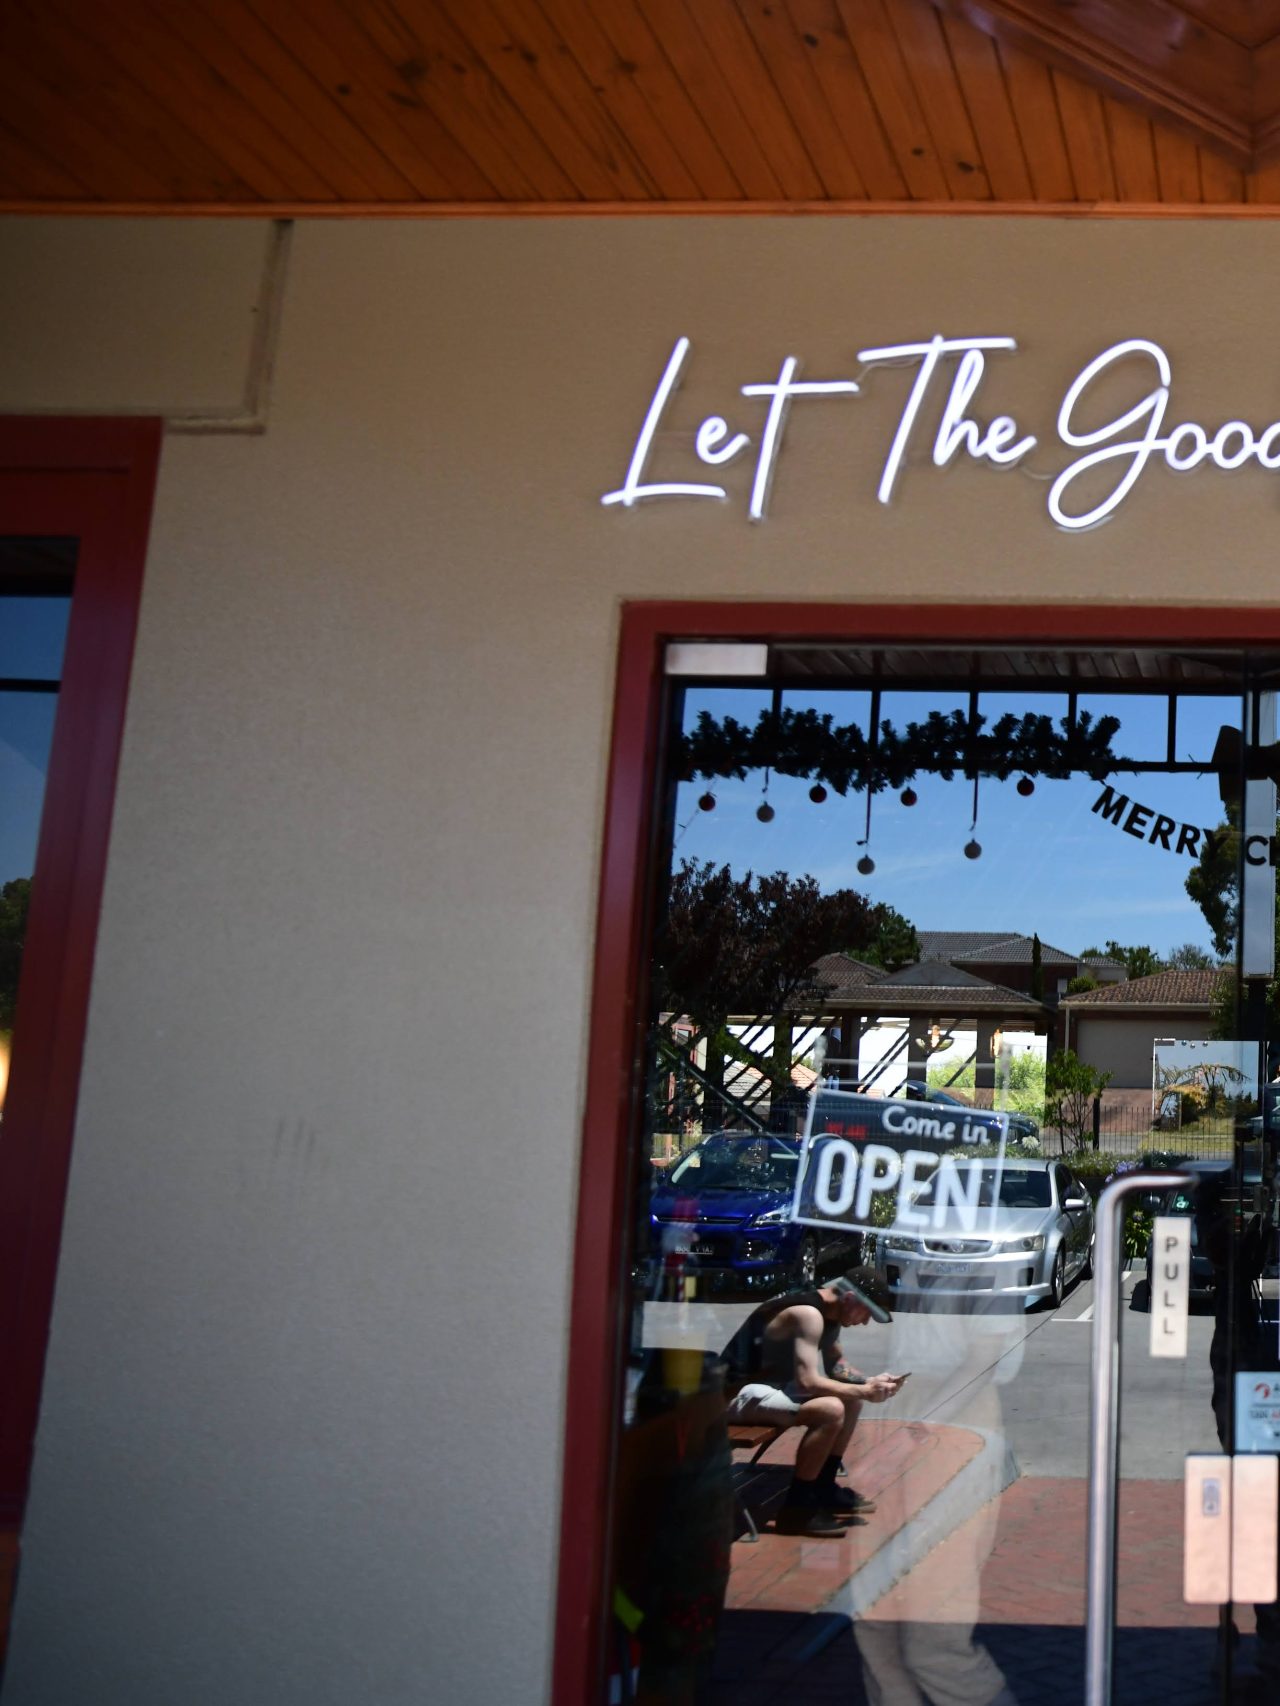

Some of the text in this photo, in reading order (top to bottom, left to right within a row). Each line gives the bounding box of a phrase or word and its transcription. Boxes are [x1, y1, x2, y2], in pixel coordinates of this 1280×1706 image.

[600, 336, 860, 522] Let
[857, 334, 1037, 504] The
[1090, 786, 1226, 859] MERRY
[882, 1105, 956, 1140] Come
[962, 1115, 991, 1144] in
[813, 1138, 984, 1233] OPEN
[1162, 1236, 1180, 1335] PULL
